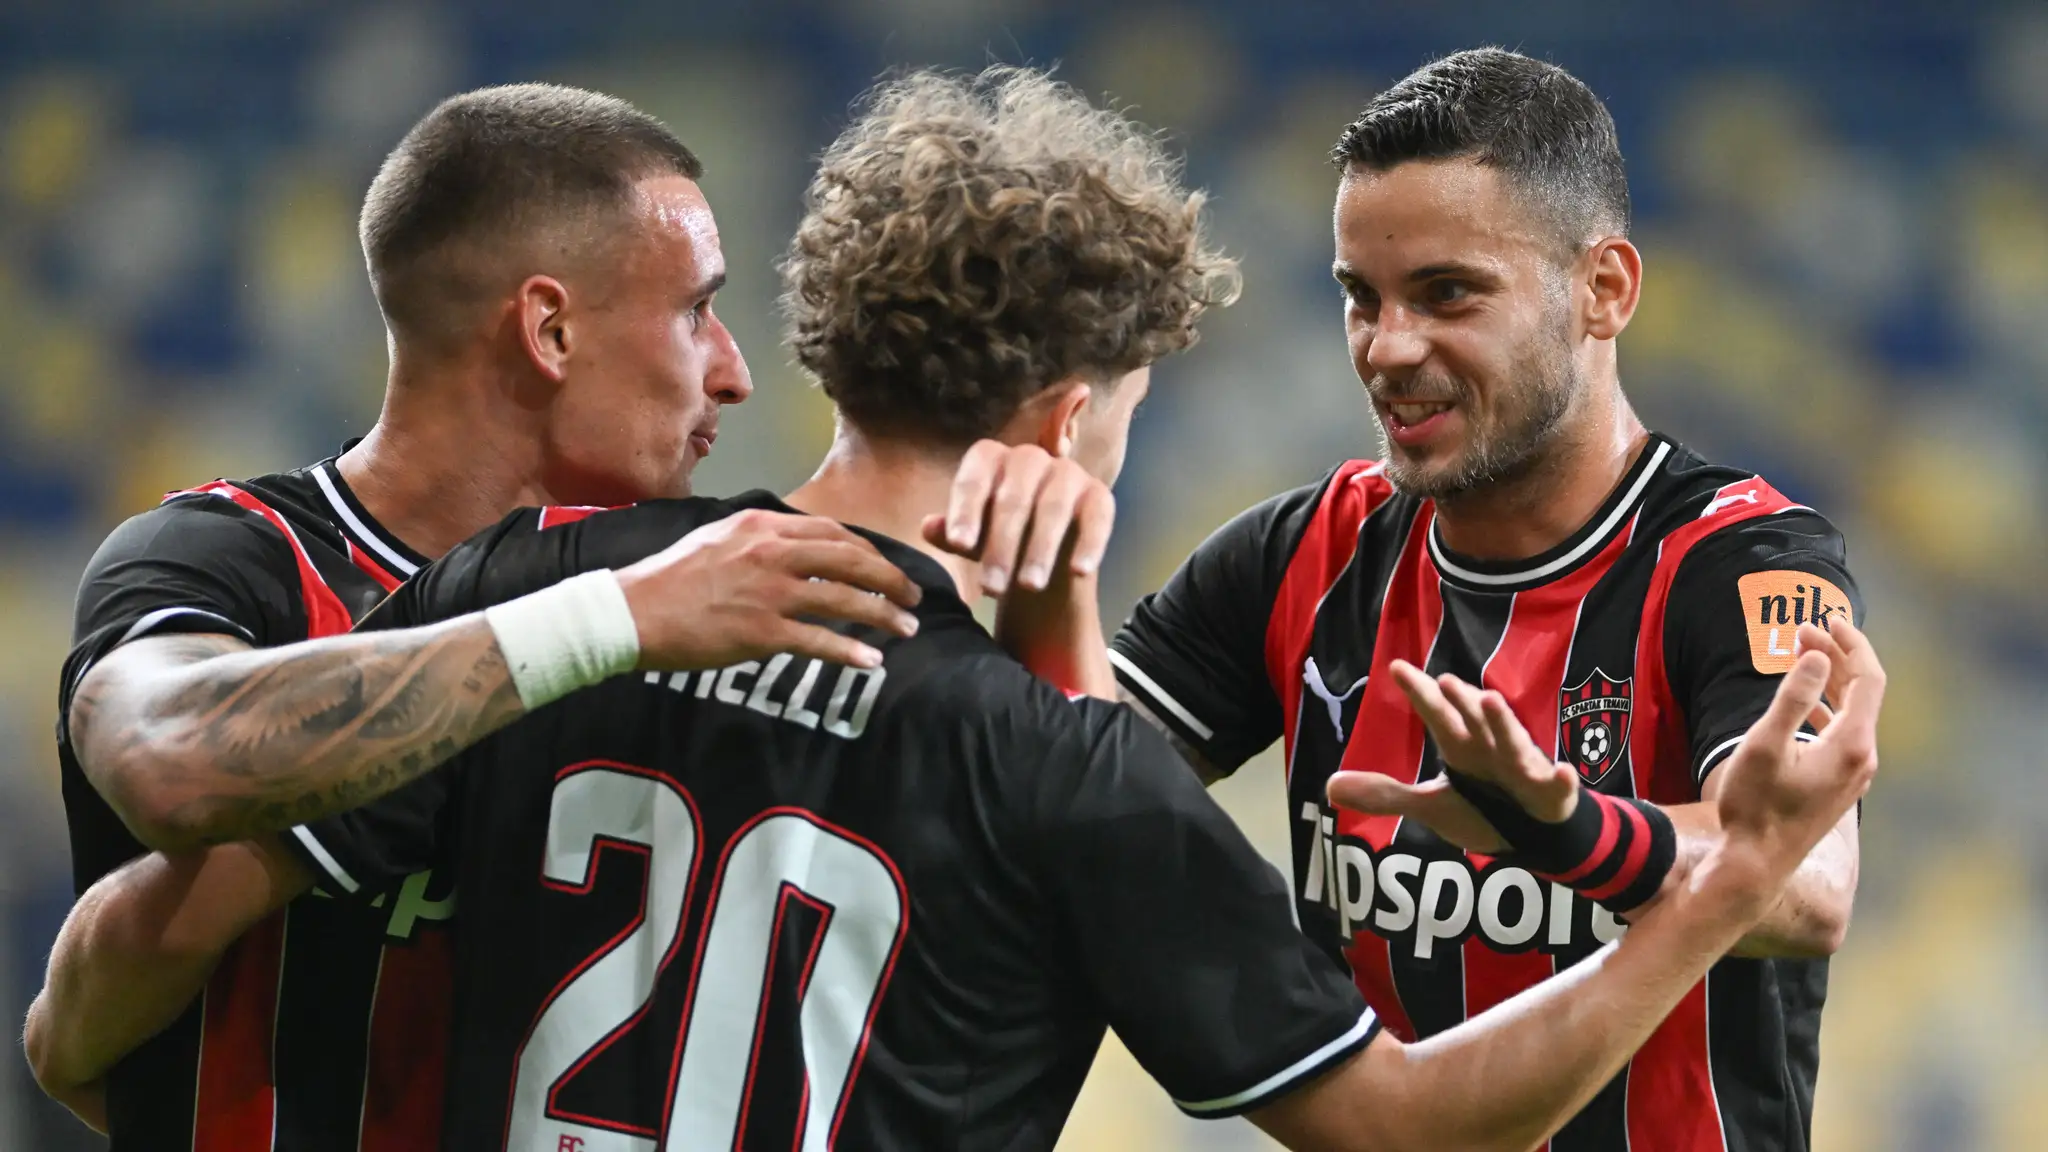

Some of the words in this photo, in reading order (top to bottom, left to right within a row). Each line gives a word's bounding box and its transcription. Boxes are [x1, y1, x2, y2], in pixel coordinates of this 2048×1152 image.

[643, 652, 887, 739] ELLO
[1562, 708, 1571, 720] FC
[1571, 699, 1602, 715] SPARTAK
[1603, 698, 1629, 710] TRNAVA
[503, 759, 910, 1152] 20
